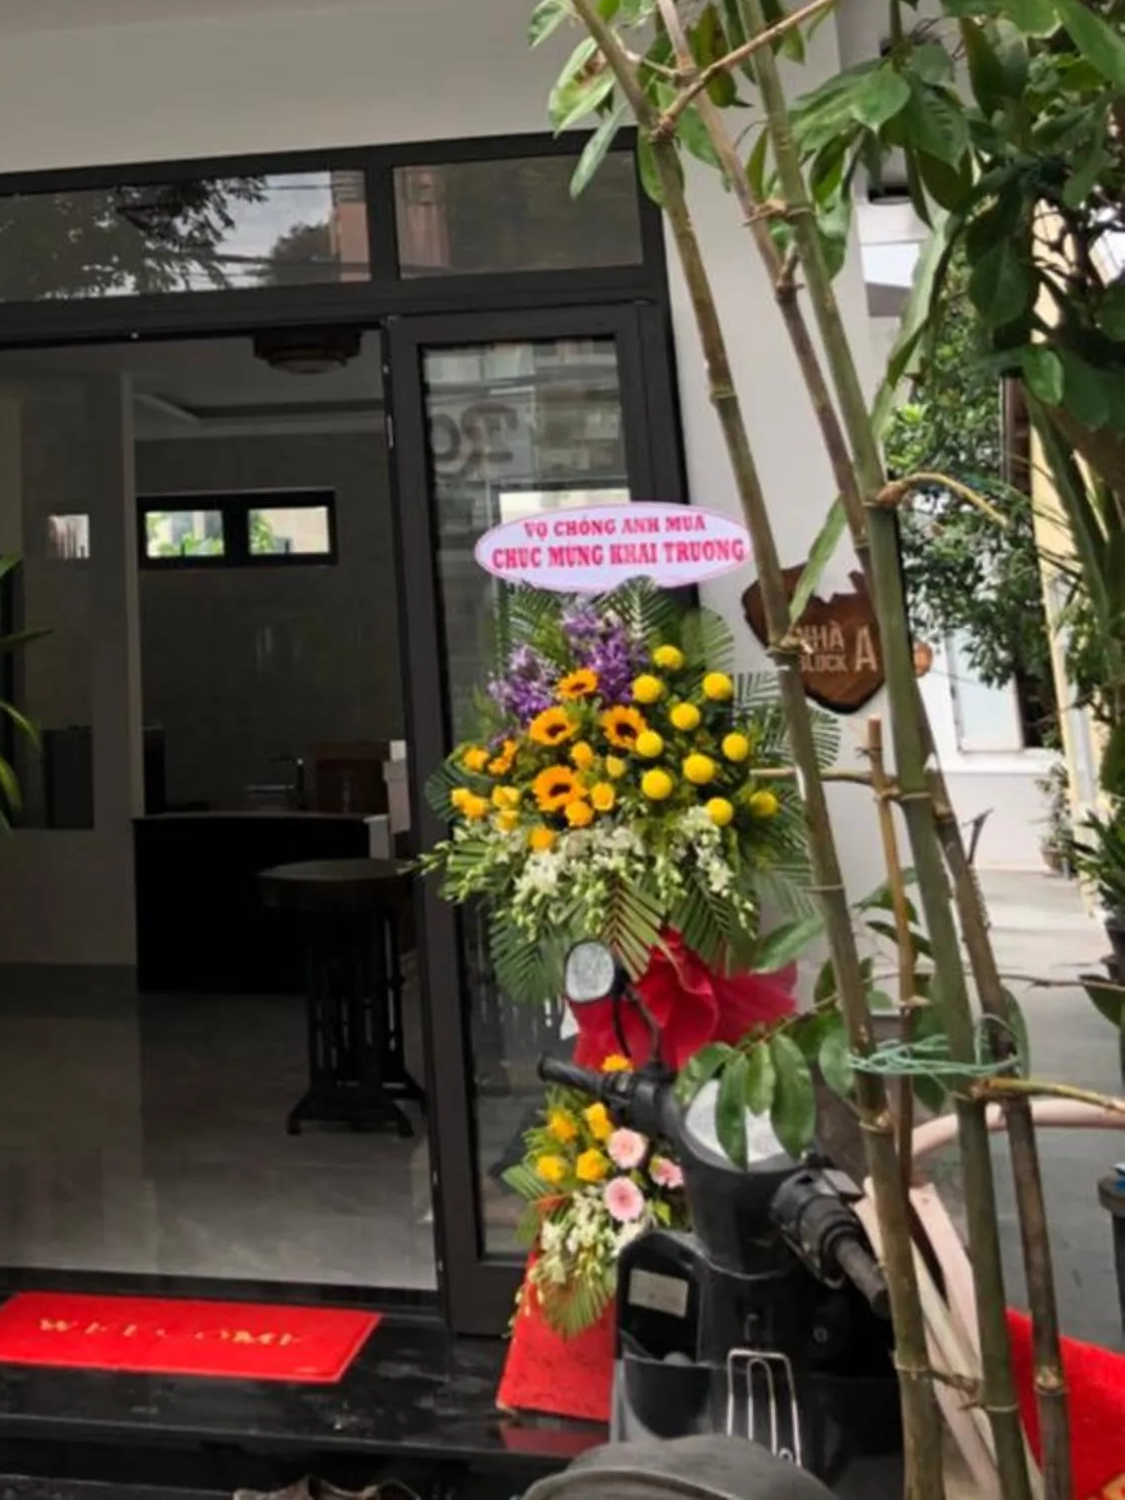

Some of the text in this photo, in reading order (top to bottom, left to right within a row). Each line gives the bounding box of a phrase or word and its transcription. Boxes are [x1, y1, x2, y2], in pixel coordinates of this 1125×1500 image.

[621, 517, 659, 534] ANH
[609, 542, 658, 565] KHAI
[854, 625, 878, 673] A
